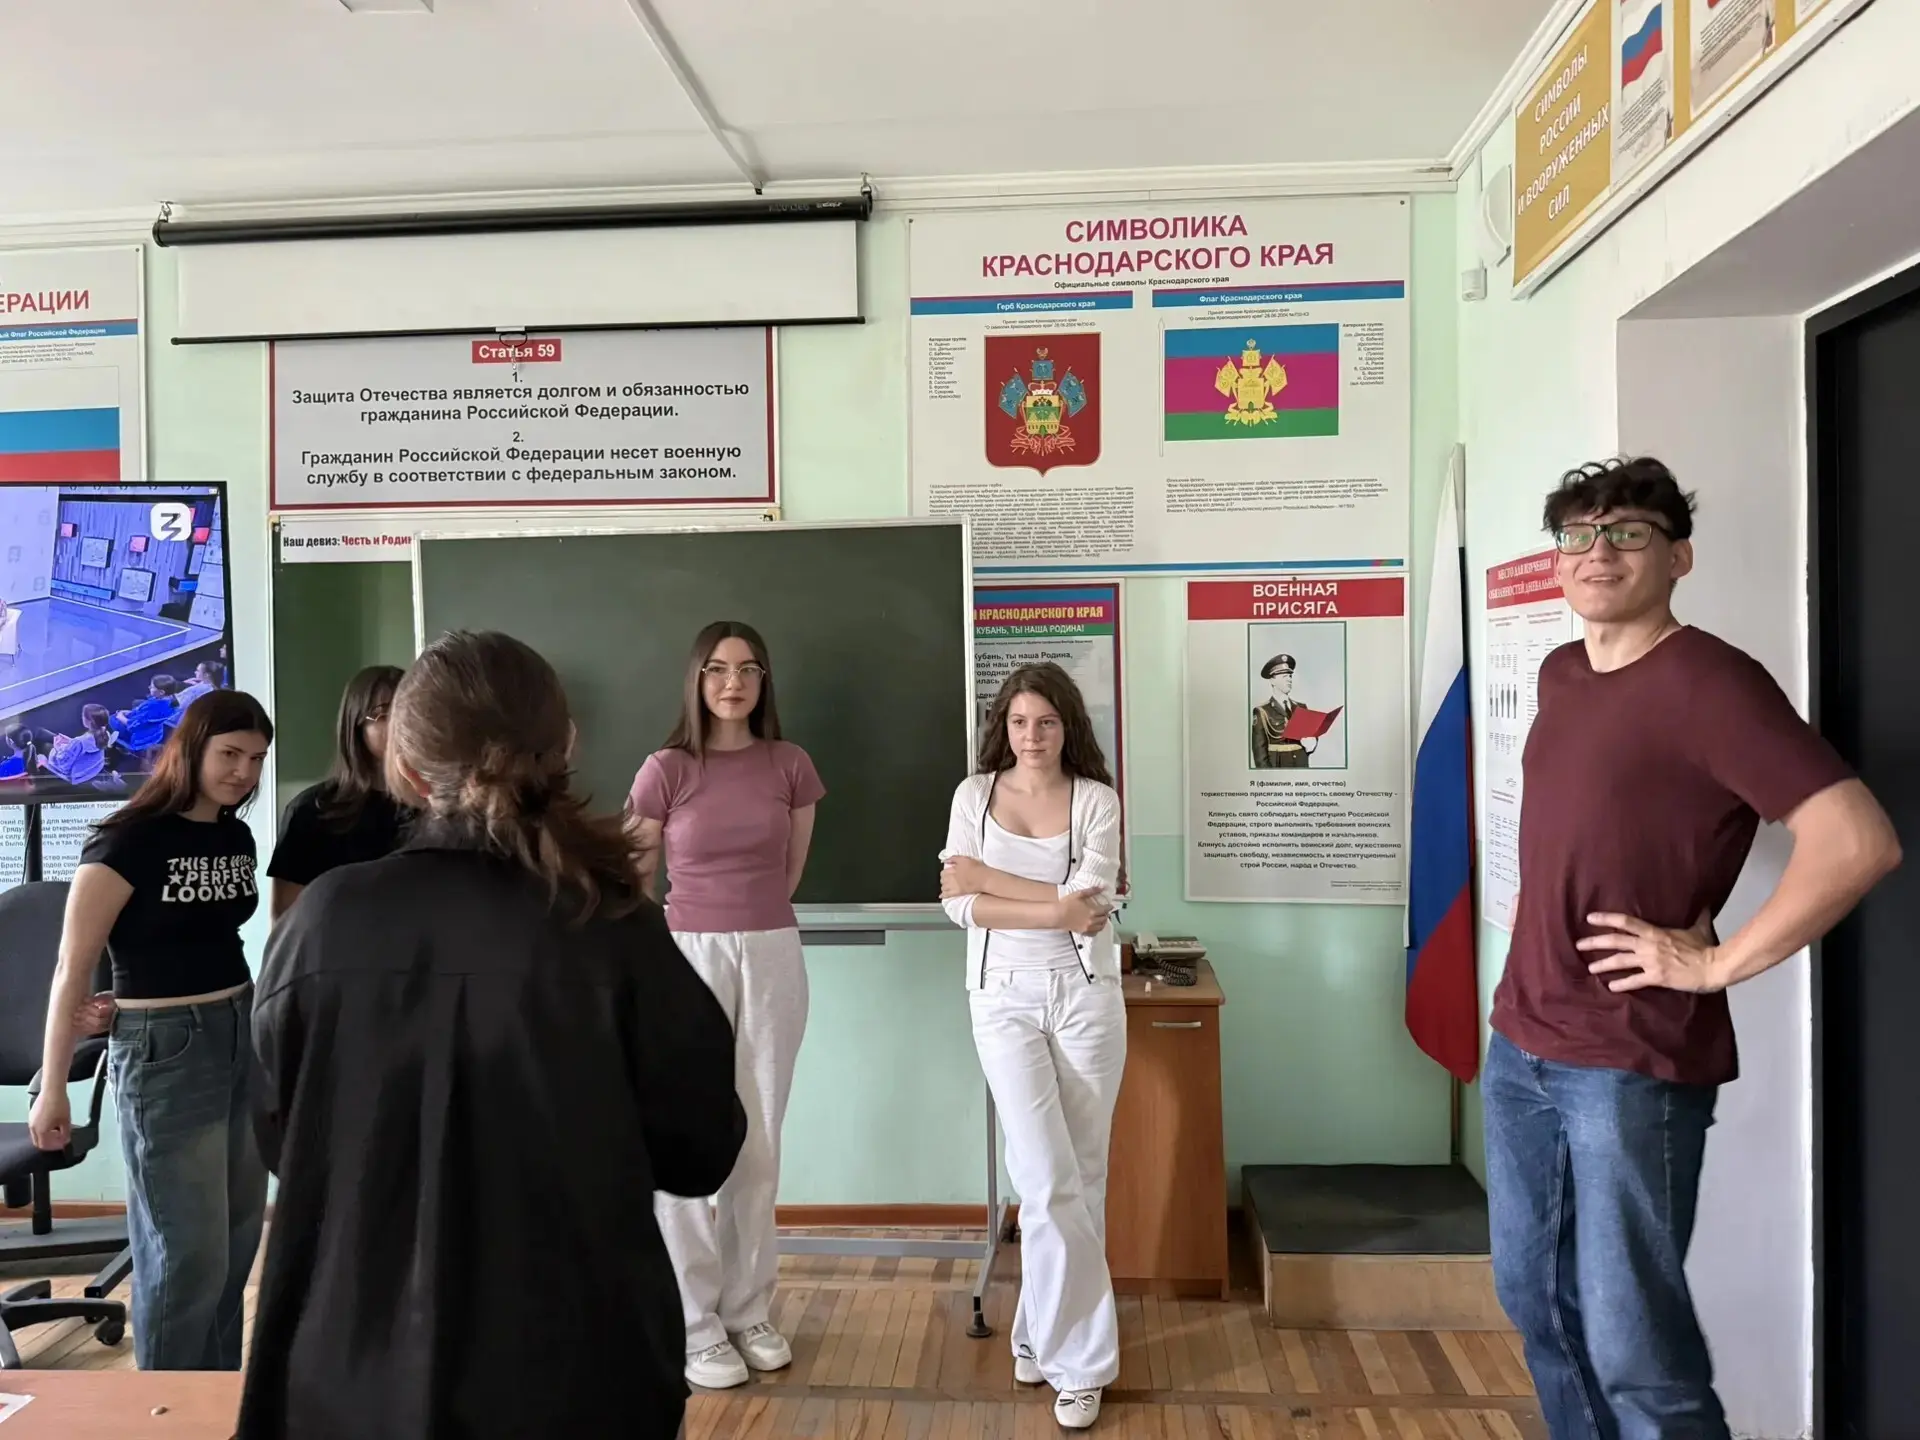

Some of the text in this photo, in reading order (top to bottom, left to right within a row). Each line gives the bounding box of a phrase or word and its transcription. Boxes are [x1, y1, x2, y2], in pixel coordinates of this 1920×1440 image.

[1534, 45, 1588, 123] СИМВОЛЫ
[1539, 93, 1582, 156] РОССИИ
[1517, 102, 1610, 216] И ВООРУЖЕННЫХ
[1548, 184, 1570, 221] СИЛ
[1066, 214, 1249, 243] СИМВОЛИКА
[982, 243, 1335, 279] КРАСНОДАРСКОГО КРАЯ
[1054, 280, 1110, 290] Официальные
[1111, 279, 1147, 287] символы
[1148, 277, 1210, 286] Краснодарского
[1199, 293, 1303, 303] Флаг Краснодарского края
[996, 301, 1096, 311] Герб Краснодарского края
[10, 330, 27, 338] Флаг
[28, 328, 67, 338] Российской
[68, 327, 107, 336] Федерации
[478, 343, 556, 359] Статья 59
[511, 371, 524, 383] 1.
[291, 382, 750, 405] Защита Отечества является долгом и обязанностью
[361, 403, 680, 425] гражданина Российской Федерации.
[512, 431, 525, 443] 2.
[301, 446, 742, 467] Гражданин Российской Федерации несет военную
[306, 466, 738, 487] службу в соответствии с федеральным законом.
[283, 536, 305, 547] Наш
[306, 536, 341, 548] девиз:
[342, 534, 372, 546] Честь
[373, 536, 380, 546] и
[1252, 582, 1339, 598] ВОЕННАЯ
[980, 607, 1075, 621] КРАСНОДАРСКОГО
[1076, 606, 1104, 618] КРАЯ
[1252, 600, 1339, 616] ПРИСЯГА
[976, 624, 1085, 635] КУБАНЬ, ТЫ НАША РОДИНА!
[1041, 651, 1073, 660] Родина,
[1256, 780, 1293, 789] (фамилия,
[1249, 791, 1284, 799] присягаю
[1295, 791, 1328, 799] верность
[1329, 791, 1355, 799] своему
[1356, 790, 1393, 799] Отечеству
[1208, 811, 1238, 819] Клянусь
[1207, 821, 1249, 829] Федерации,
[1315, 821, 1357, 829] требования
[1197, 841, 1227, 849] Клянусь
[1239, 851, 1271, 860] свободу,
[1332, 852, 1396, 860] конституционный
[166, 856, 209, 872] THIS
[212, 856, 228, 870] IS
[1240, 861, 1261, 869] строй
[1261, 861, 1289, 869] России,
[161, 884, 238, 903] LOOKS
